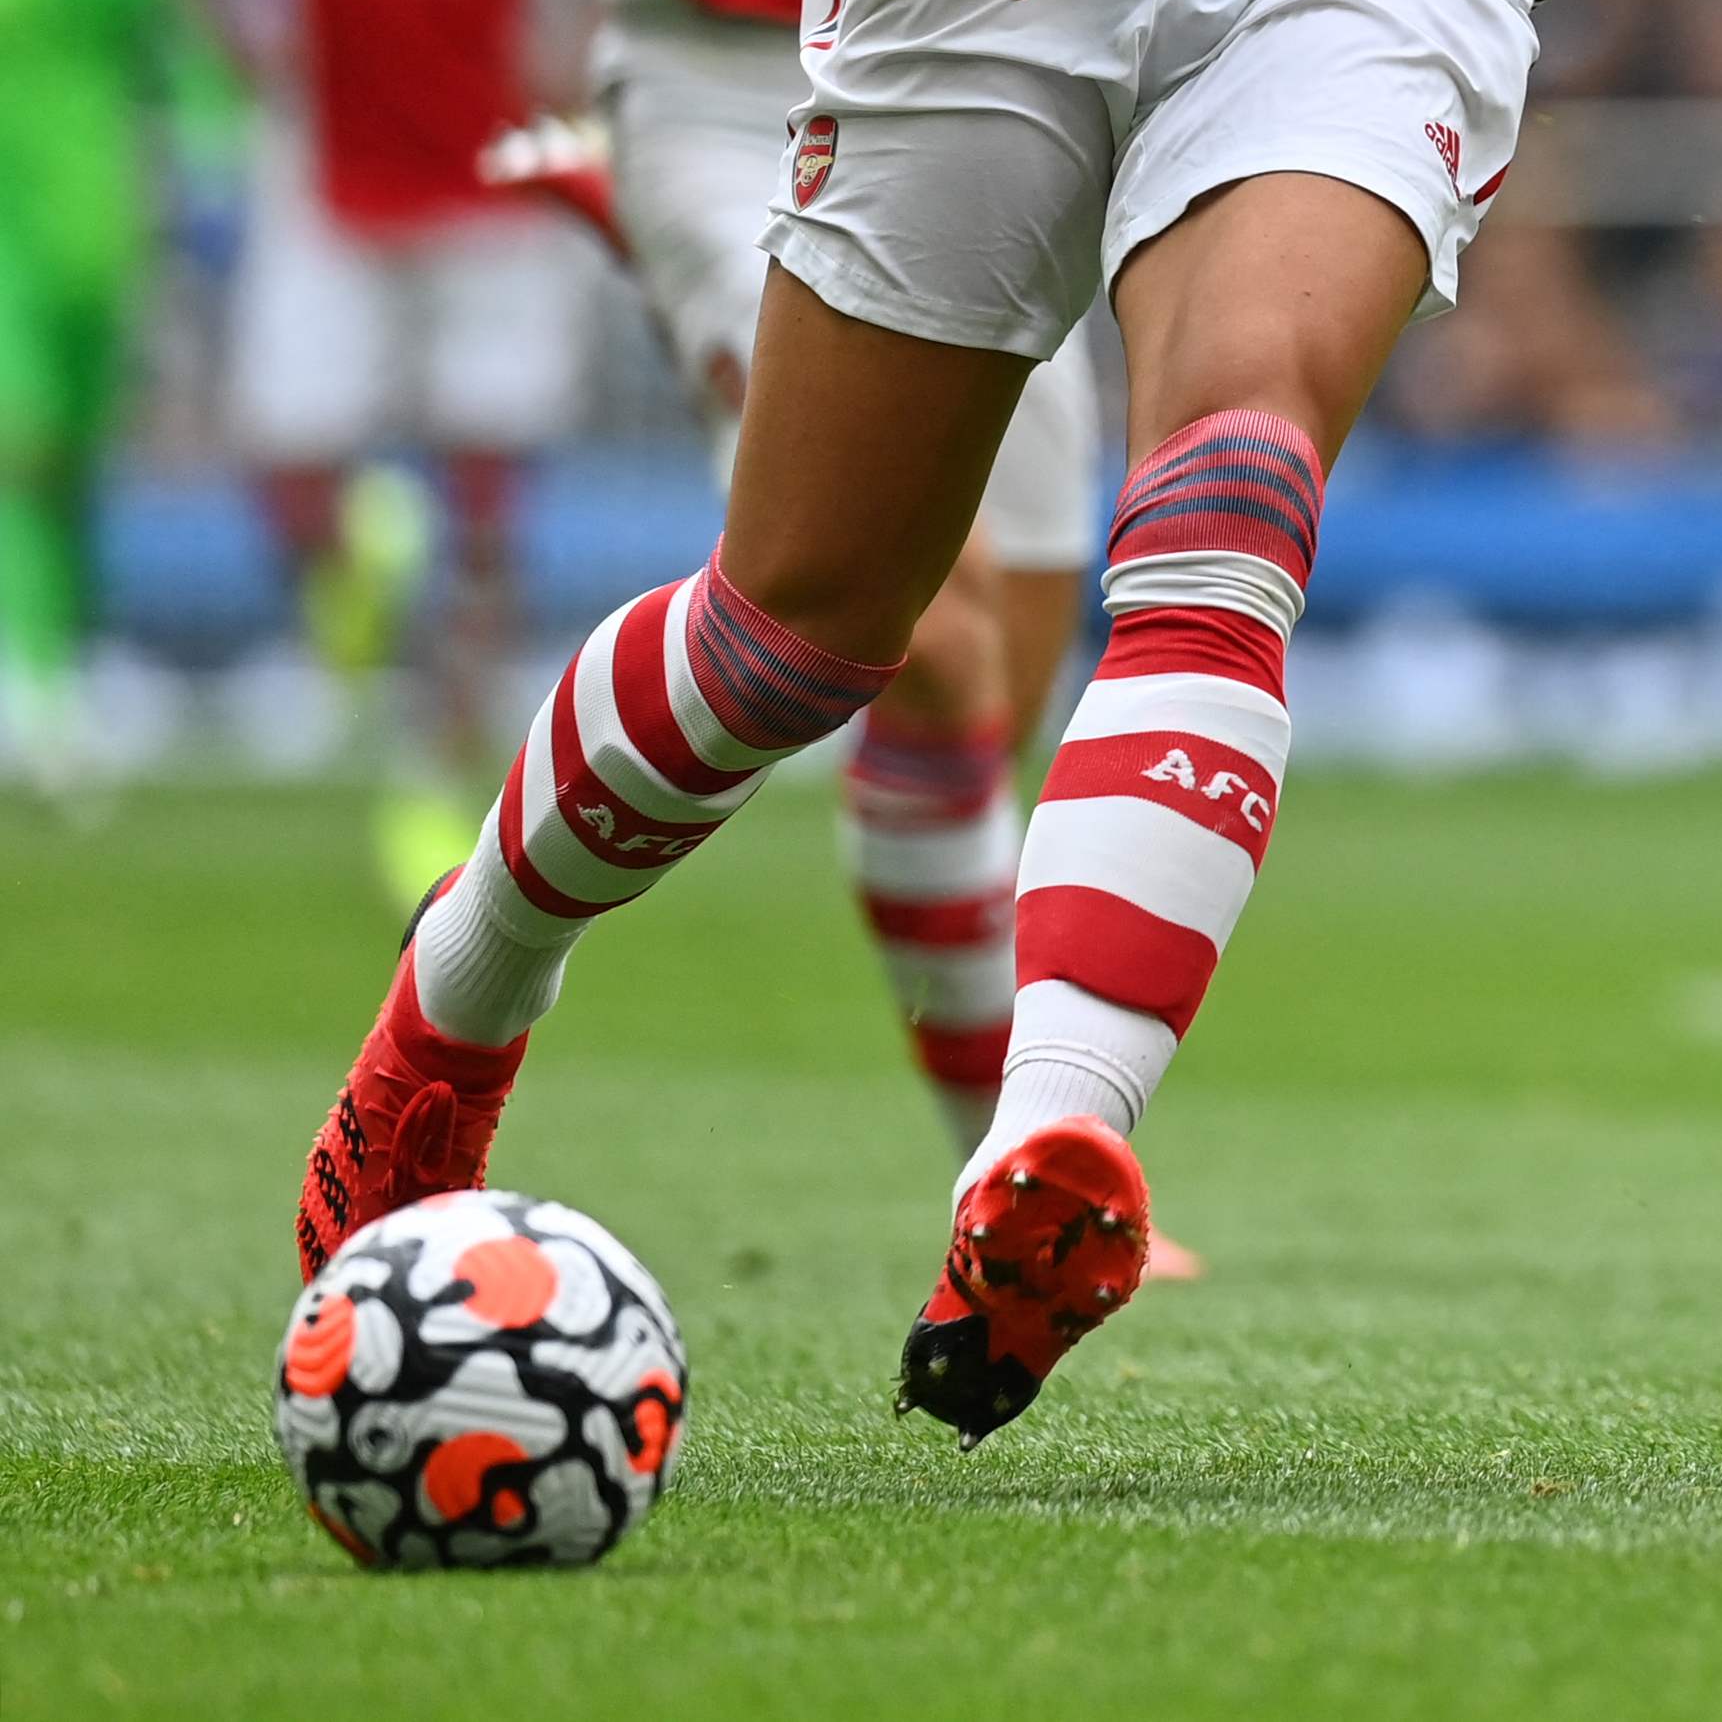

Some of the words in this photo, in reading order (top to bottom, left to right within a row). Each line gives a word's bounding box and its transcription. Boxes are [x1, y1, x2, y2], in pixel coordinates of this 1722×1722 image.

[1424, 123, 1462, 202] adid
[577, 803, 708, 851] AFC
[1140, 749, 1270, 832] AFC
